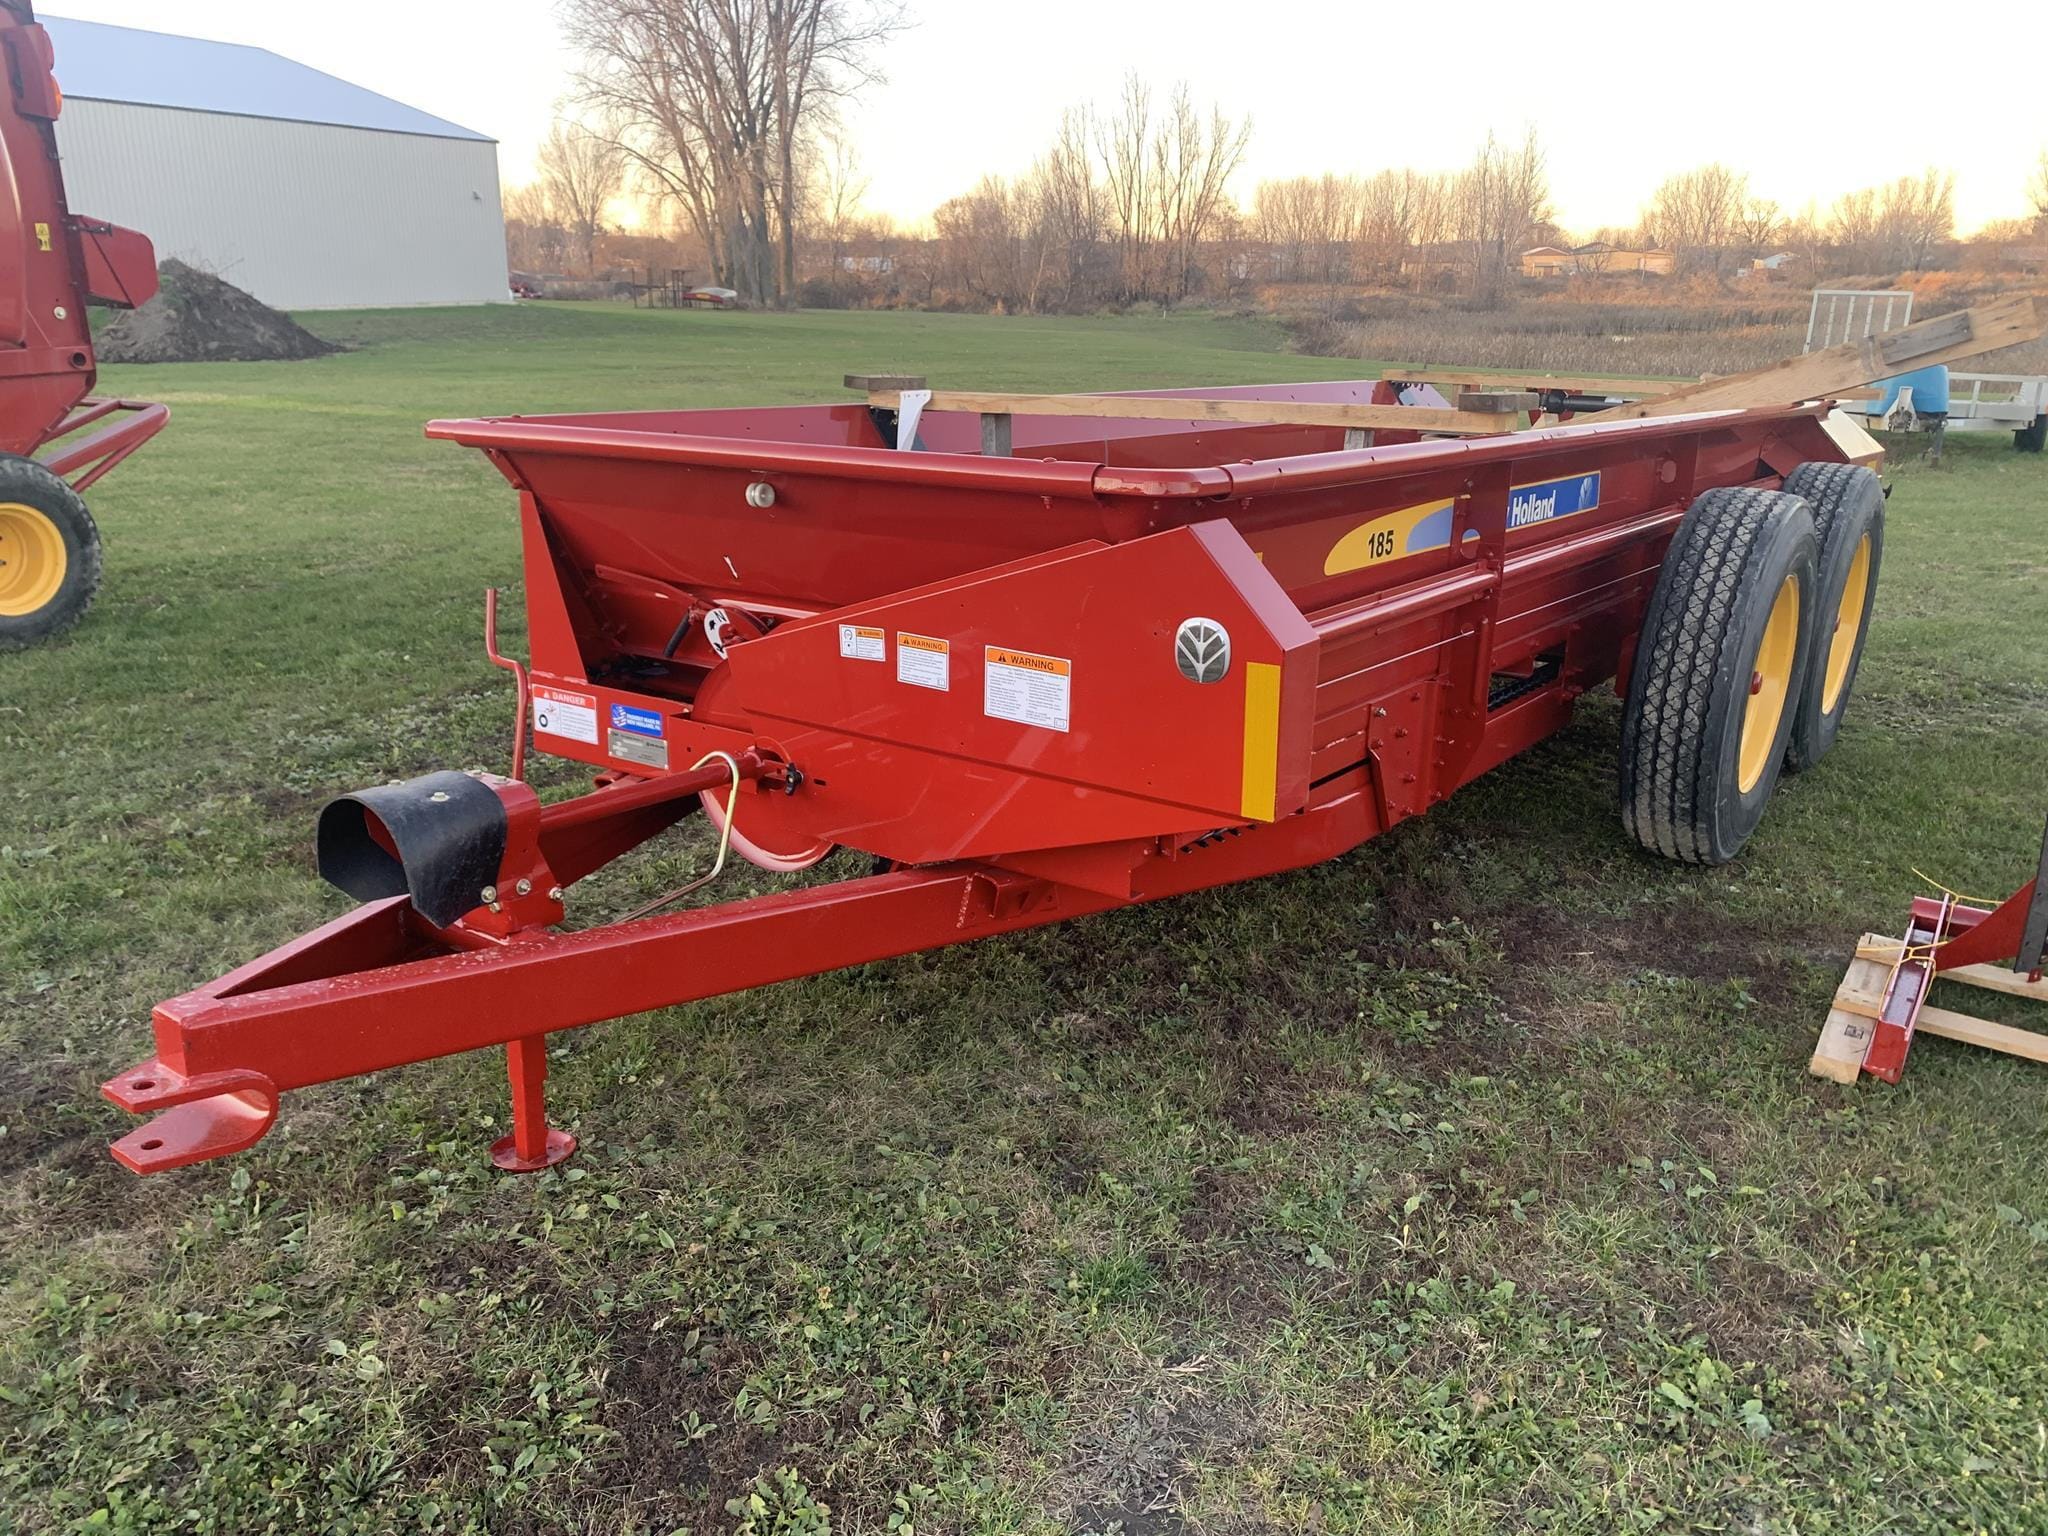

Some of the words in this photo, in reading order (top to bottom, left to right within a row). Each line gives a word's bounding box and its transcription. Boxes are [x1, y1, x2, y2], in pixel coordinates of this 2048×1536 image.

[1511, 489, 1556, 527] Holland
[1368, 529, 1394, 559] 185
[911, 639, 943, 650] WARNING
[1010, 655, 1054, 671] WARNING
[552, 691, 585, 705] DANGER
